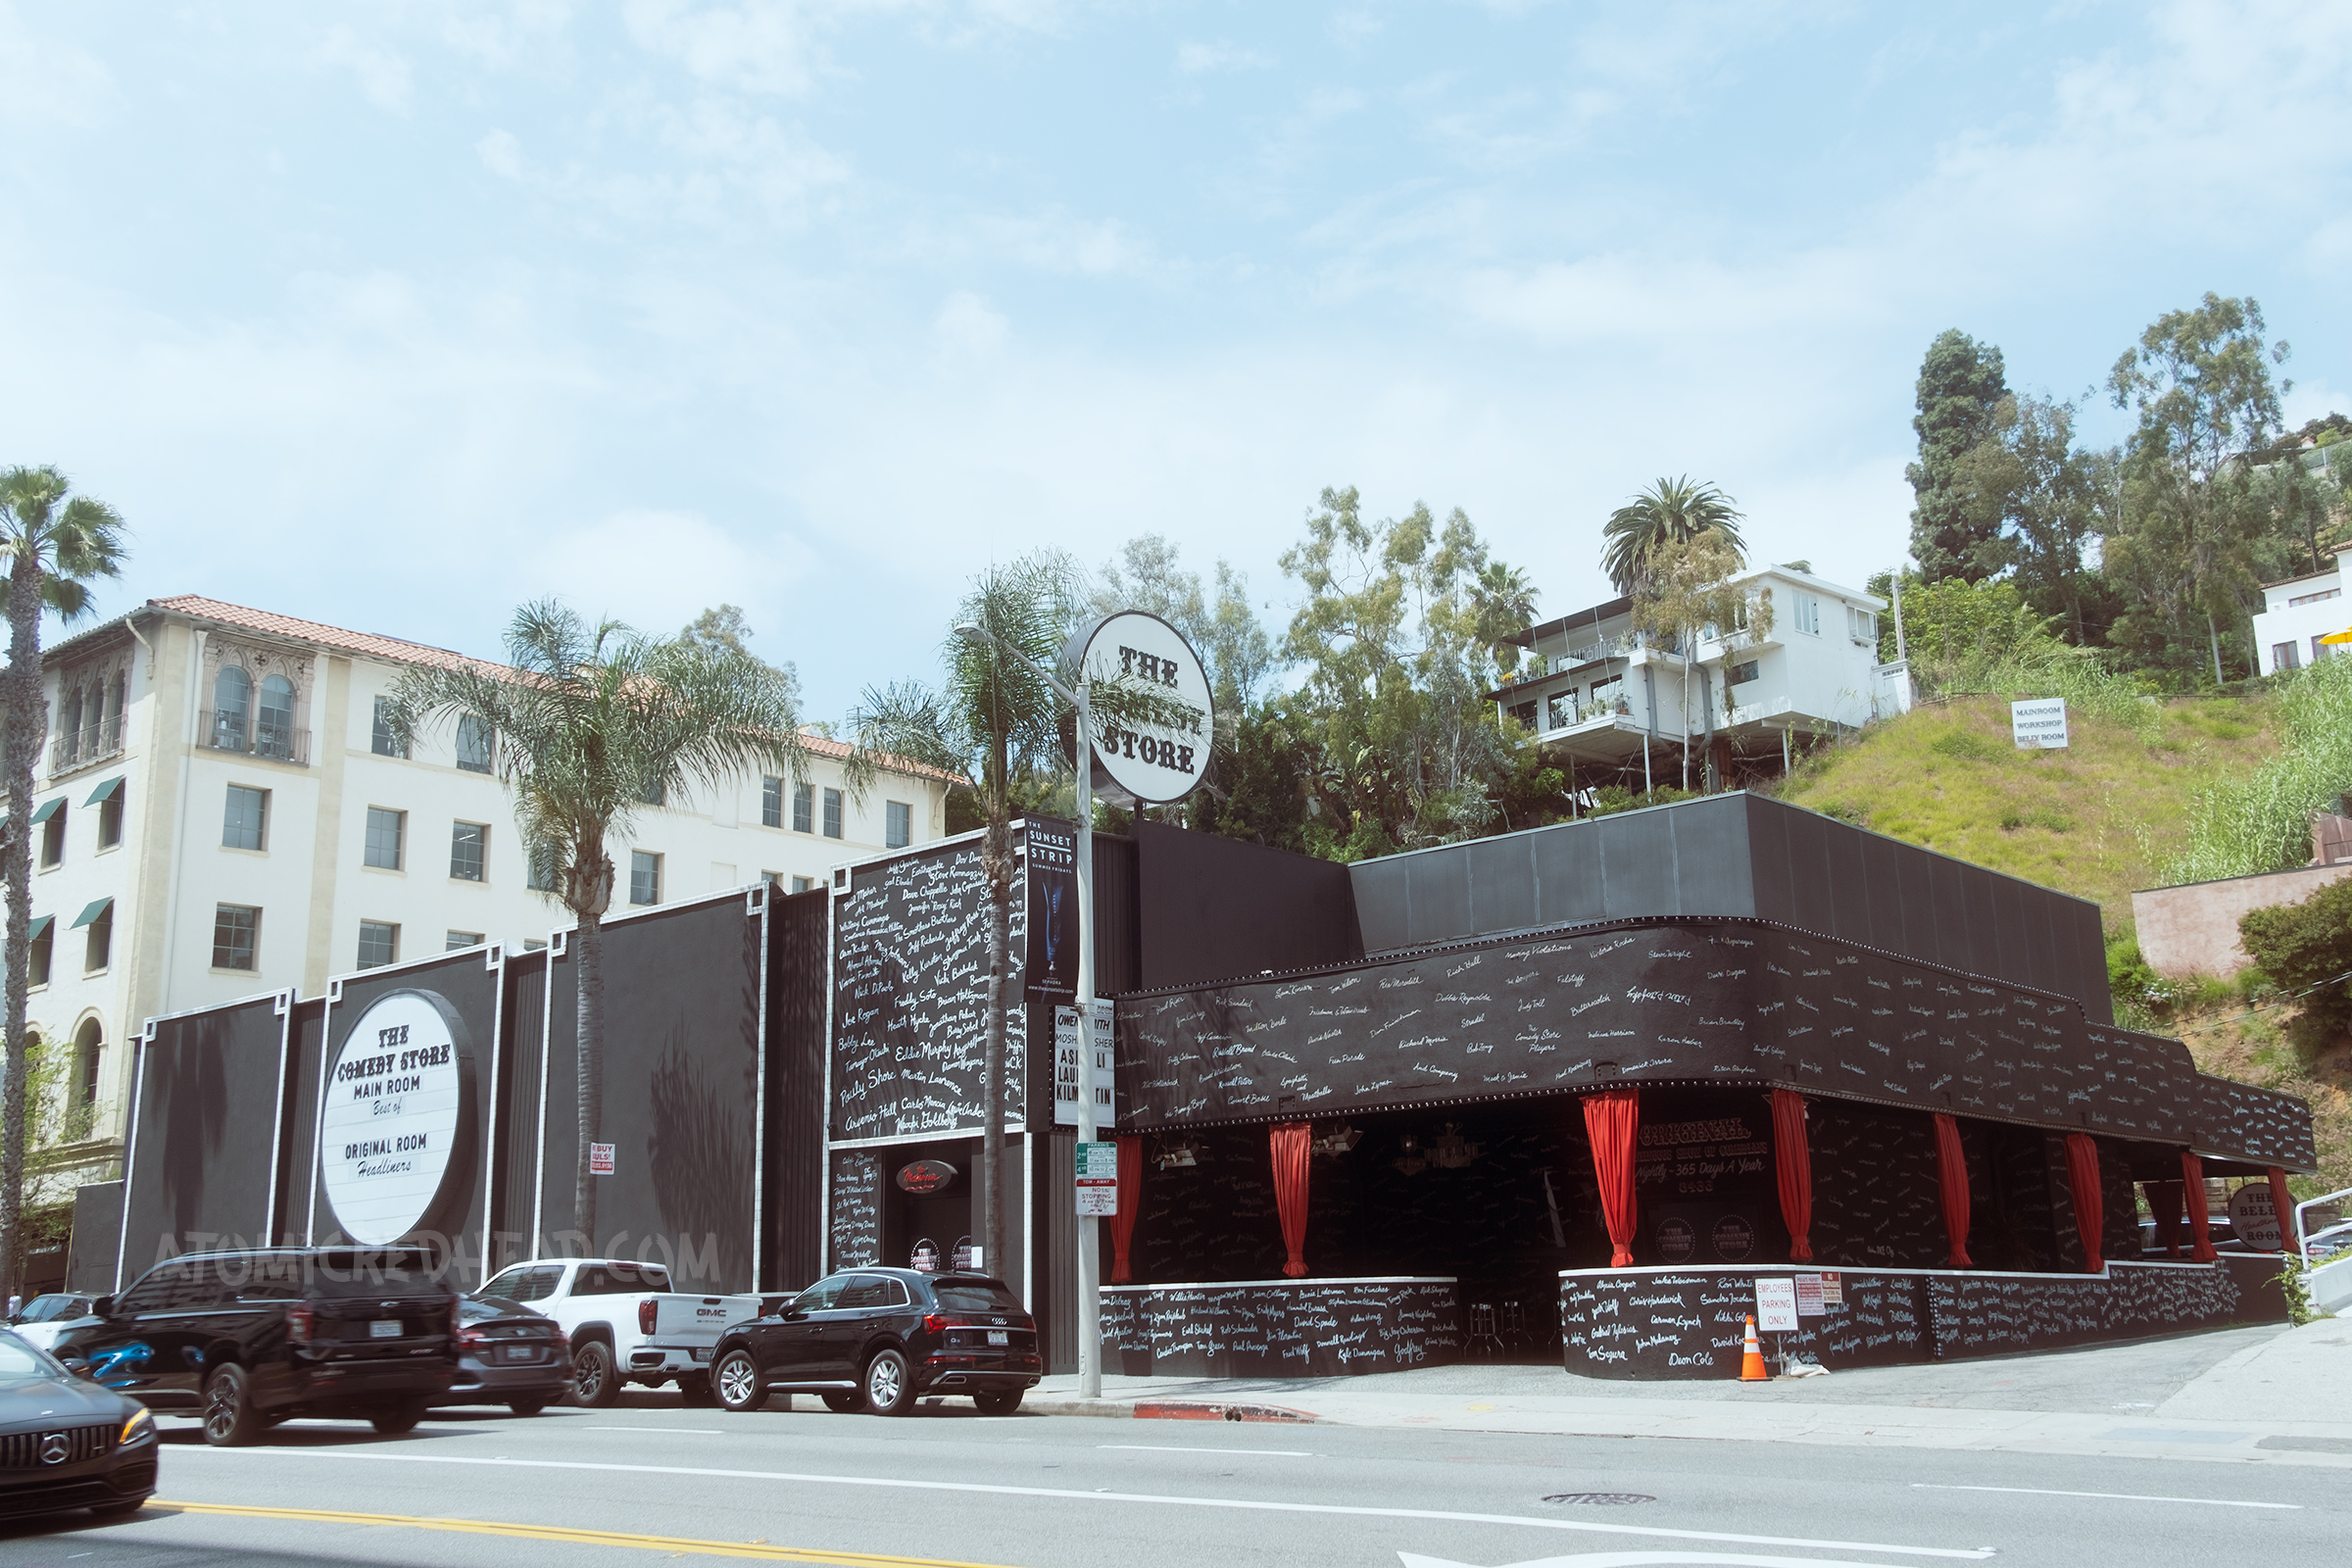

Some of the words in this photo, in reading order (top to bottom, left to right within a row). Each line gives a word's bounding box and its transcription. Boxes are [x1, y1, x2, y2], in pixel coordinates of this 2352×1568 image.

[1119, 646, 1178, 689] THE
[2016, 707, 2061, 716] MAINROOM
[2017, 719, 2062, 729] WORKSHOP
[1103, 725, 1194, 775] STORE
[1029, 830, 1071, 847] SUNSET
[1031, 848, 1072, 864] STRIP
[843, 1012, 856, 1029] Joe
[858, 1008, 879, 1024] Rogan
[379, 1024, 410, 1048] THE
[860, 1032, 875, 1047] Lee
[895, 1046, 921, 1062] Eddie
[919, 1040, 952, 1061] Murphy
[1234, 1044, 1257, 1055] Brand
[337, 1054, 396, 1082] COMEDY
[400, 1044, 451, 1070] STORE
[354, 1081, 382, 1100] MAIN
[387, 1075, 420, 1094] ROOM
[868, 1068, 896, 1089] Shore
[373, 1100, 392, 1115] Best
[393, 1097, 403, 1114] of
[878, 1101, 897, 1119] Hall
[1639, 1118, 1751, 1146] ORIGINAL
[345, 1139, 392, 1159] ORIGINAL
[396, 1133, 427, 1152] ROOM
[357, 1157, 412, 1177] Headliners
[1636, 1163, 1666, 1183] Nightly
[1675, 1163, 1696, 1176] 365
[1699, 1162, 1725, 1179] Days
[1725, 1160, 1735, 1174] A
[1739, 1158, 1766, 1174] Year
[2239, 1206, 2276, 1216] BELL
[1717, 1278, 1732, 1288] Ron
[1758, 1283, 1792, 1293] EMPLOYEES
[697, 1309, 727, 1317] GMC
[1762, 1299, 1791, 1309] PARKING
[1294, 1316, 1313, 1327] David
[1314, 1316, 1338, 1331] Spade
[1768, 1316, 1787, 1325] ONLY
[1394, 1339, 1427, 1362] Godfrey
[1692, 1351, 1714, 1366] Cole
